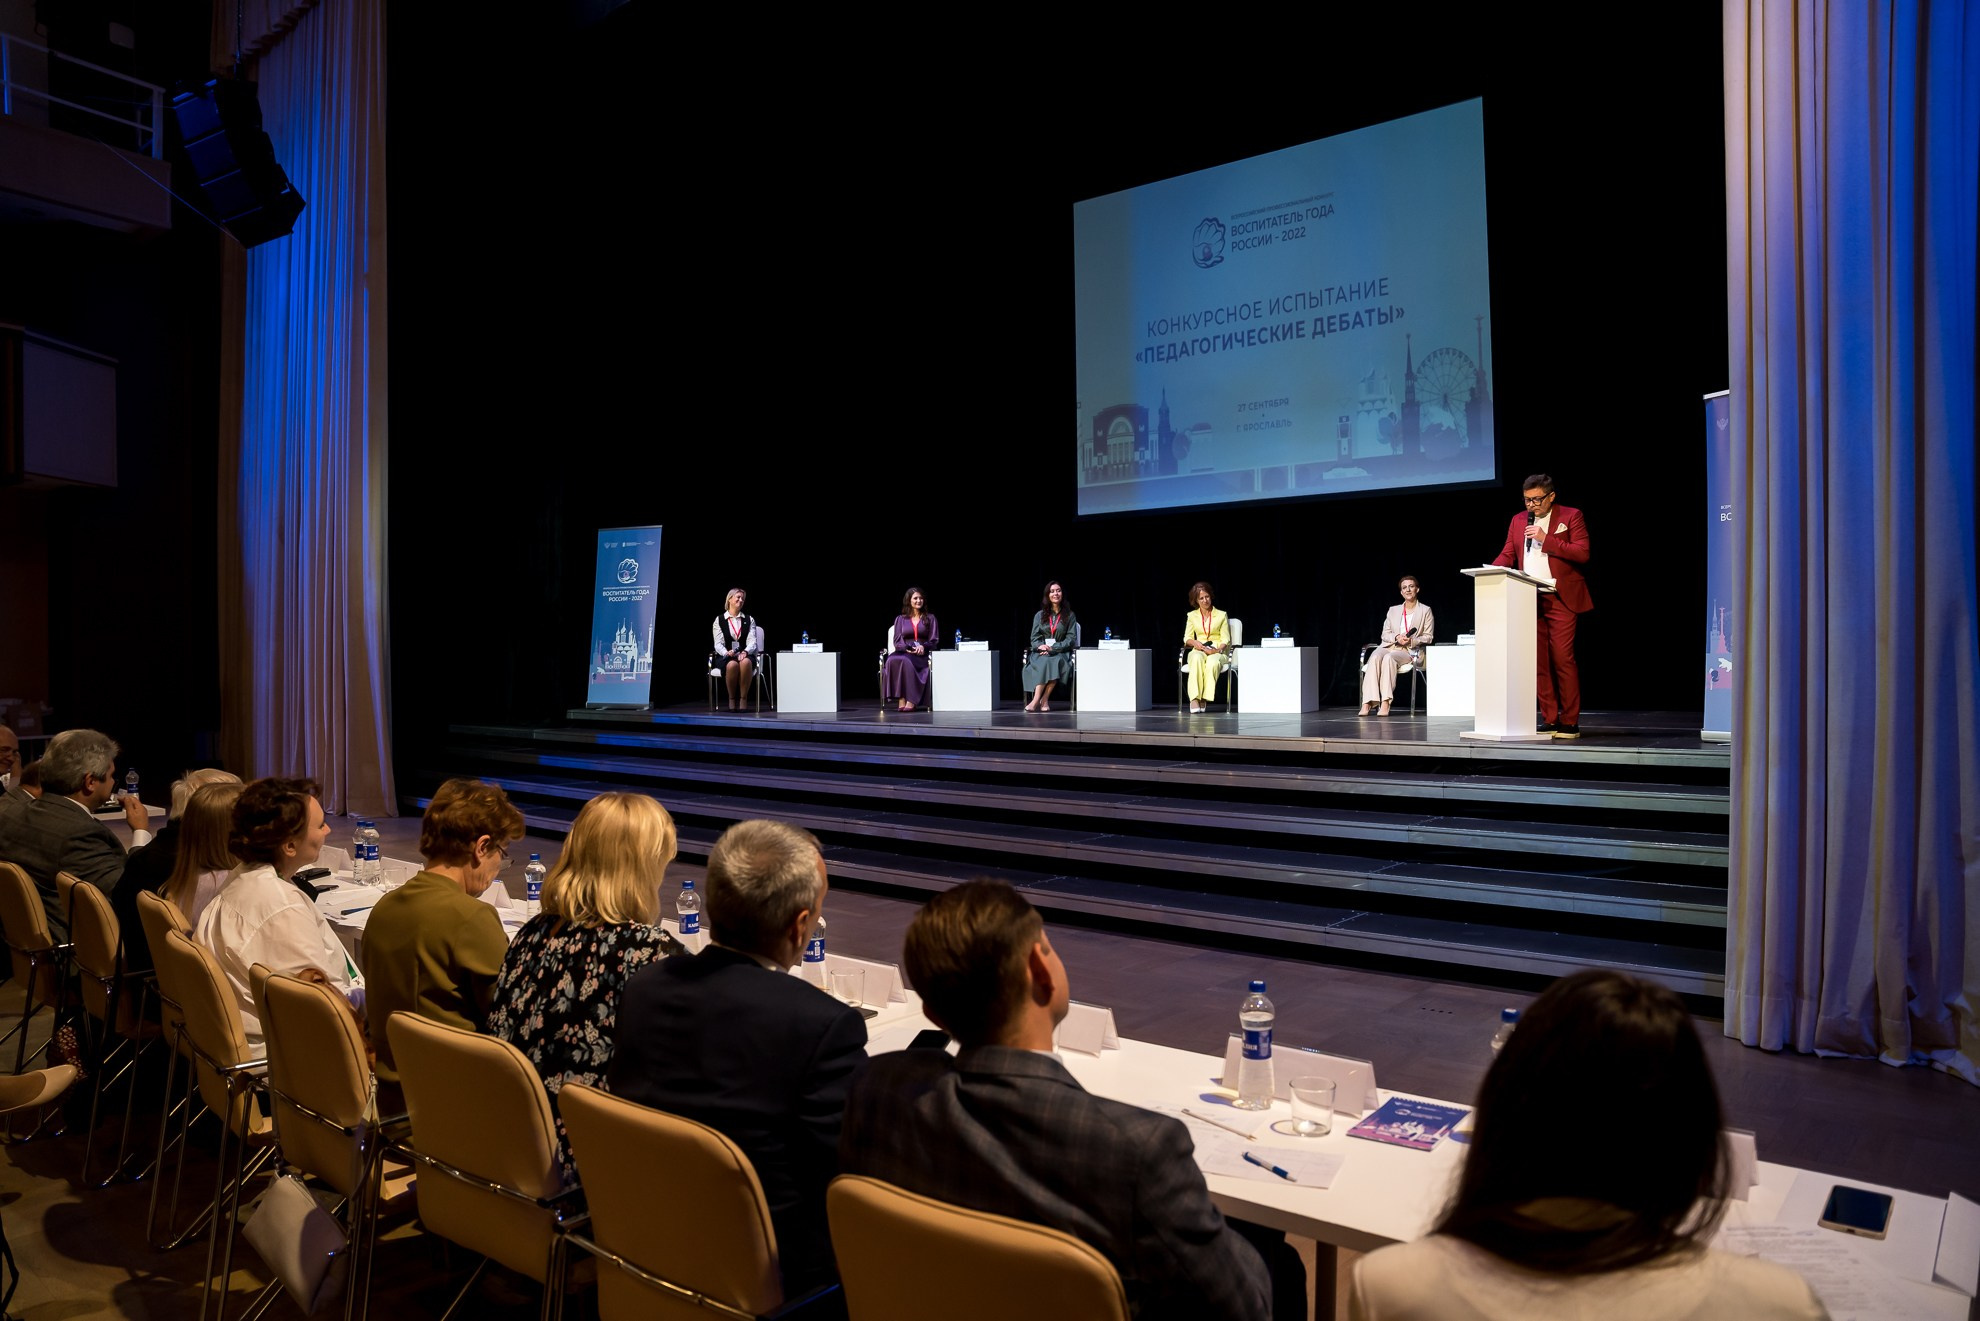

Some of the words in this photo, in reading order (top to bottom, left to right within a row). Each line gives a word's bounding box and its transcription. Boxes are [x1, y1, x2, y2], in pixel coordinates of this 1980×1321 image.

[1231, 210, 1304, 237] ВОСПИТАТЕЛЬ
[1305, 203, 1335, 220] ГОДА
[1231, 233, 1273, 252] РОССИИ
[1281, 226, 1306, 242] 2022
[1147, 300, 1263, 338] КОНКУРСНОЕ
[1269, 277, 1389, 316] ИСПЫТАНИЕ
[1135, 320, 1306, 364] «ПЕДАГОГИЧЕСКИЕ
[1311, 305, 1405, 339] ДЕБАТЫ»
[1237, 403, 1246, 413] 27
[1248, 397, 1289, 411] СЕНТЯБРЯ
[1243, 418, 1293, 432] ЯРОСЛАВЛЬ
